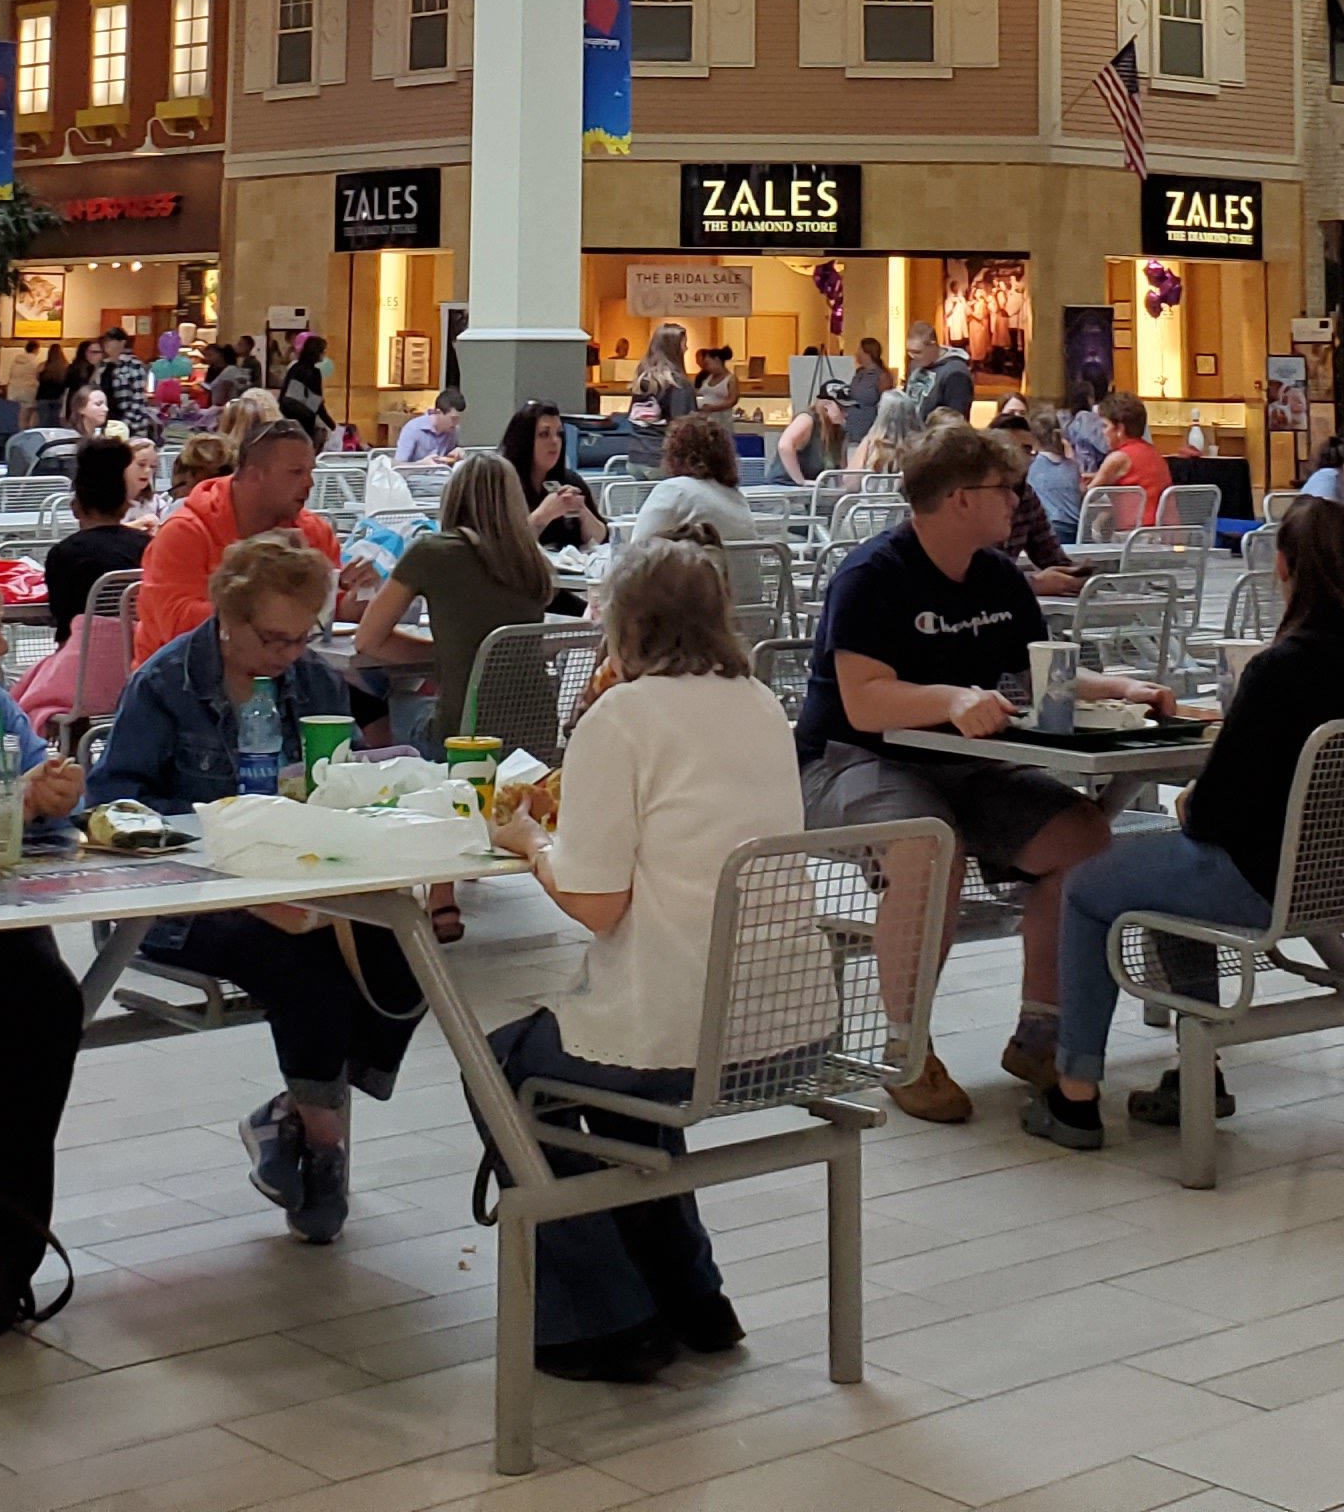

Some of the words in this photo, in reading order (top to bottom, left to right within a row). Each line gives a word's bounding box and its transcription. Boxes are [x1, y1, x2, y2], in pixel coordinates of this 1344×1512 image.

[342, 185, 419, 222] ZALES
[702, 179, 839, 217] ZALES
[1165, 191, 1254, 231] ZALES
[702, 220, 729, 233] THE
[731, 219, 793, 233] DIAMOND
[795, 221, 838, 233] STORE
[637, 273, 660, 284] THE
[665, 273, 709, 284] BRIDAL
[712, 273, 744, 285] SALE
[716, 292, 740, 304] OFF
[914, 610, 1013, 637] Champion
